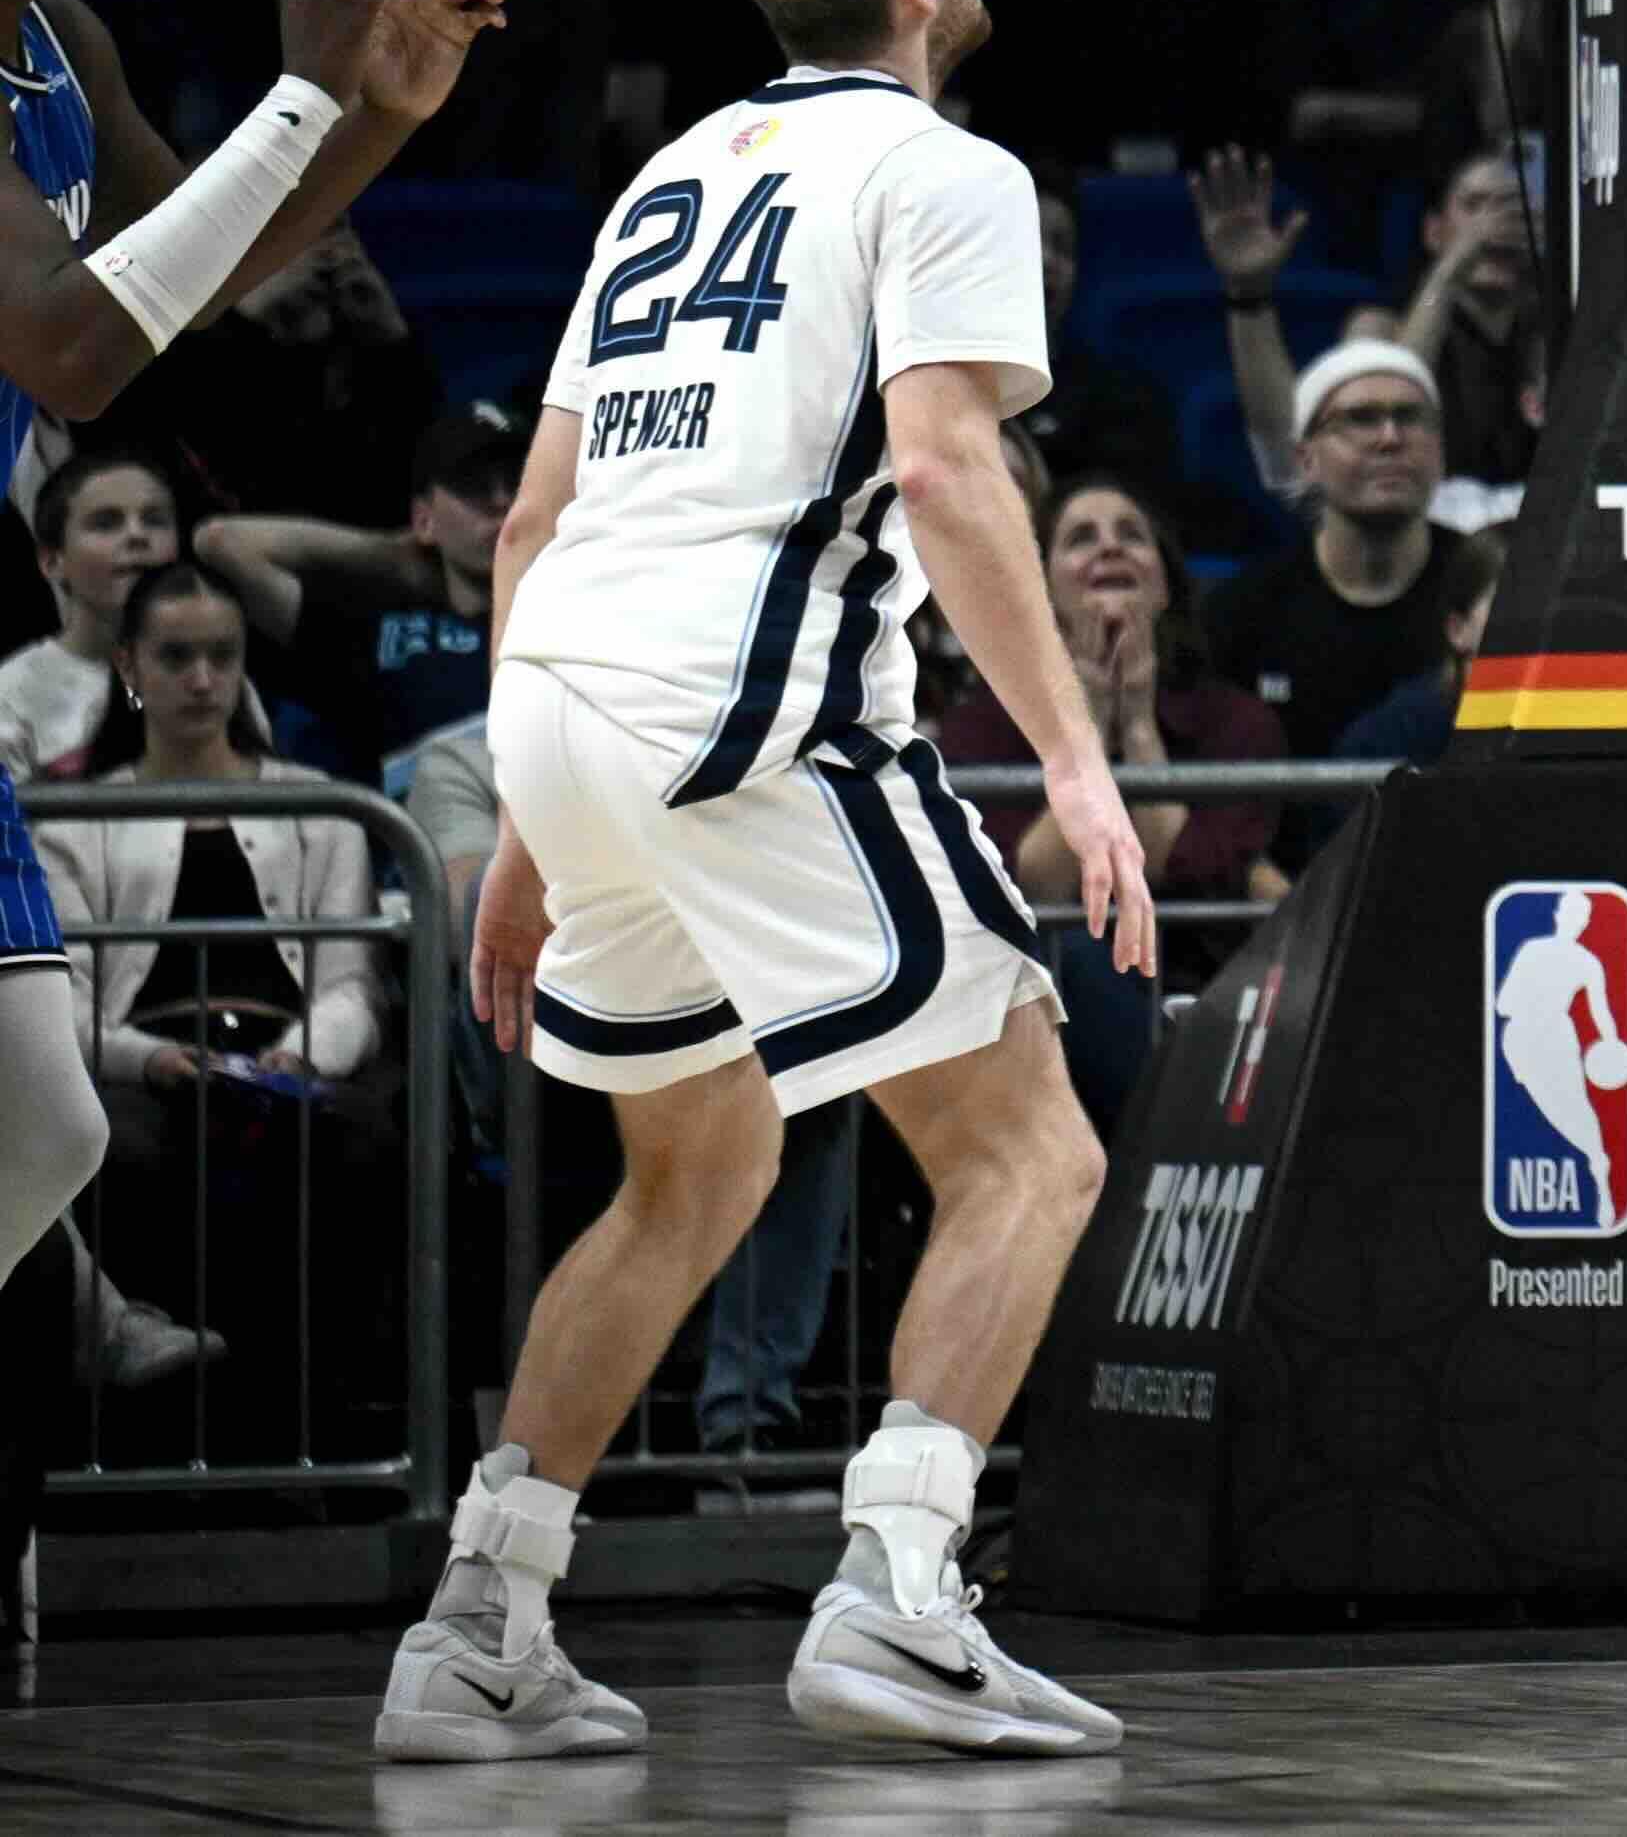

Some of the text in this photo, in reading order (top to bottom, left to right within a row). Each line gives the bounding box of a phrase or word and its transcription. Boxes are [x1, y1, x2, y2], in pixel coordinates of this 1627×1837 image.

[586, 172, 798, 369] 24
[588, 381, 717, 462] SPENCER
[1508, 1158, 1582, 1214] NBA
[1114, 1164, 1264, 1330] TISSOT
[1488, 1260, 1624, 1308] Presented
